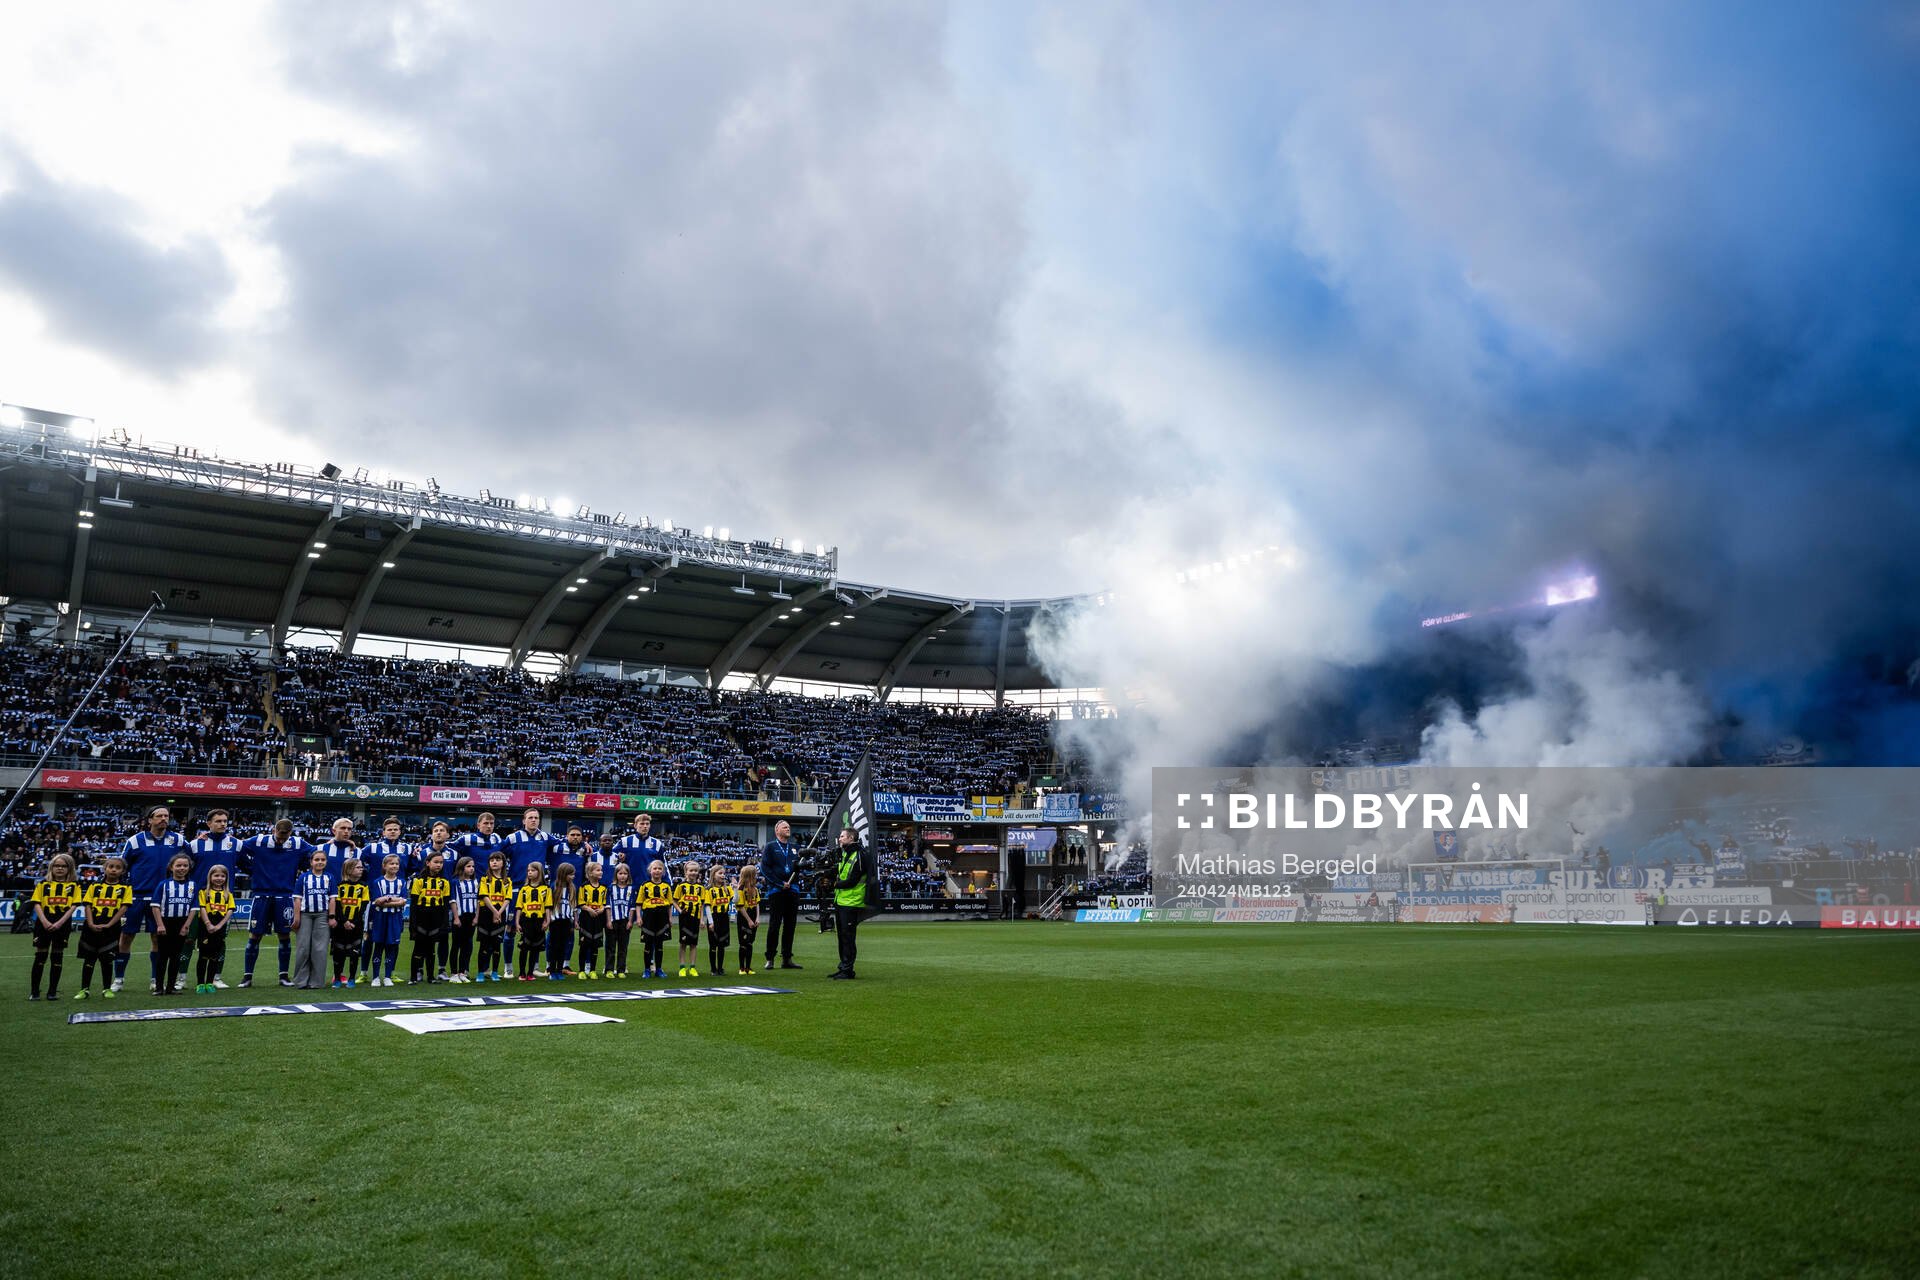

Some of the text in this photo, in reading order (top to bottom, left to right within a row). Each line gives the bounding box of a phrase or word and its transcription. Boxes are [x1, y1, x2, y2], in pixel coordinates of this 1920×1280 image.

[170, 588, 200, 600] F5
[428, 617, 454, 628] F4
[642, 641, 665, 651] F3
[820, 661, 841, 671] F2
[933, 669, 950, 678] F1
[311, 785, 414, 798] Härryda Karlsson
[644, 798, 687, 811] Picadeli
[1127, 897, 1155, 907] OPTIK
[1084, 910, 1132, 921] EFFEKTIV
[1226, 909, 1293, 921] INTERSPORT
[1706, 909, 1793, 926] ELEDA
